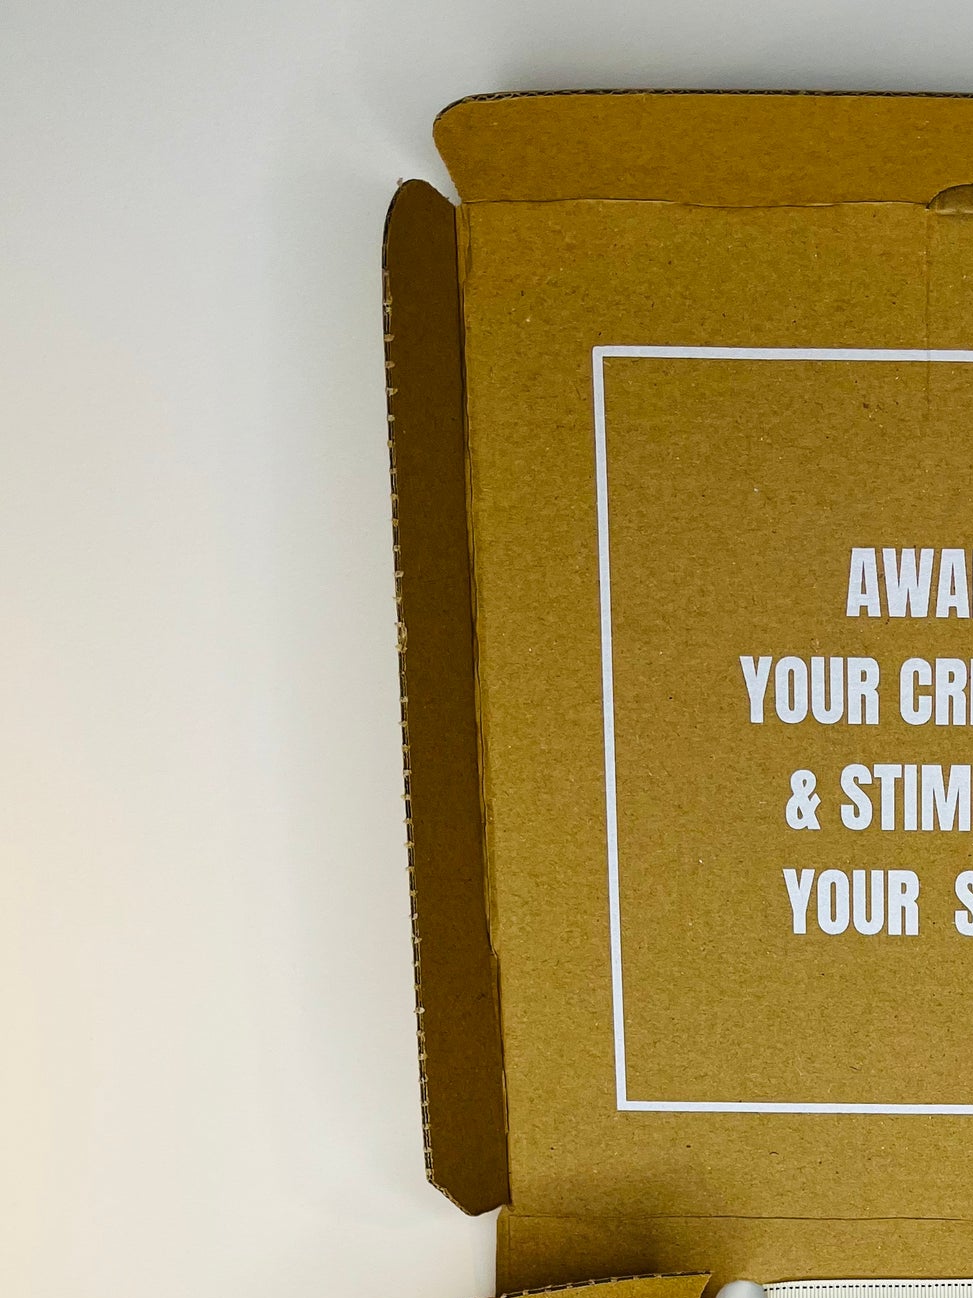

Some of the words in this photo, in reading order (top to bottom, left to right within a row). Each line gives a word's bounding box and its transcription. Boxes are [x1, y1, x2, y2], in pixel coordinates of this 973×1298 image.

[739, 655, 881, 724] YOUR
[785, 769, 822, 831] &
[782, 868, 920, 936] YOUR
